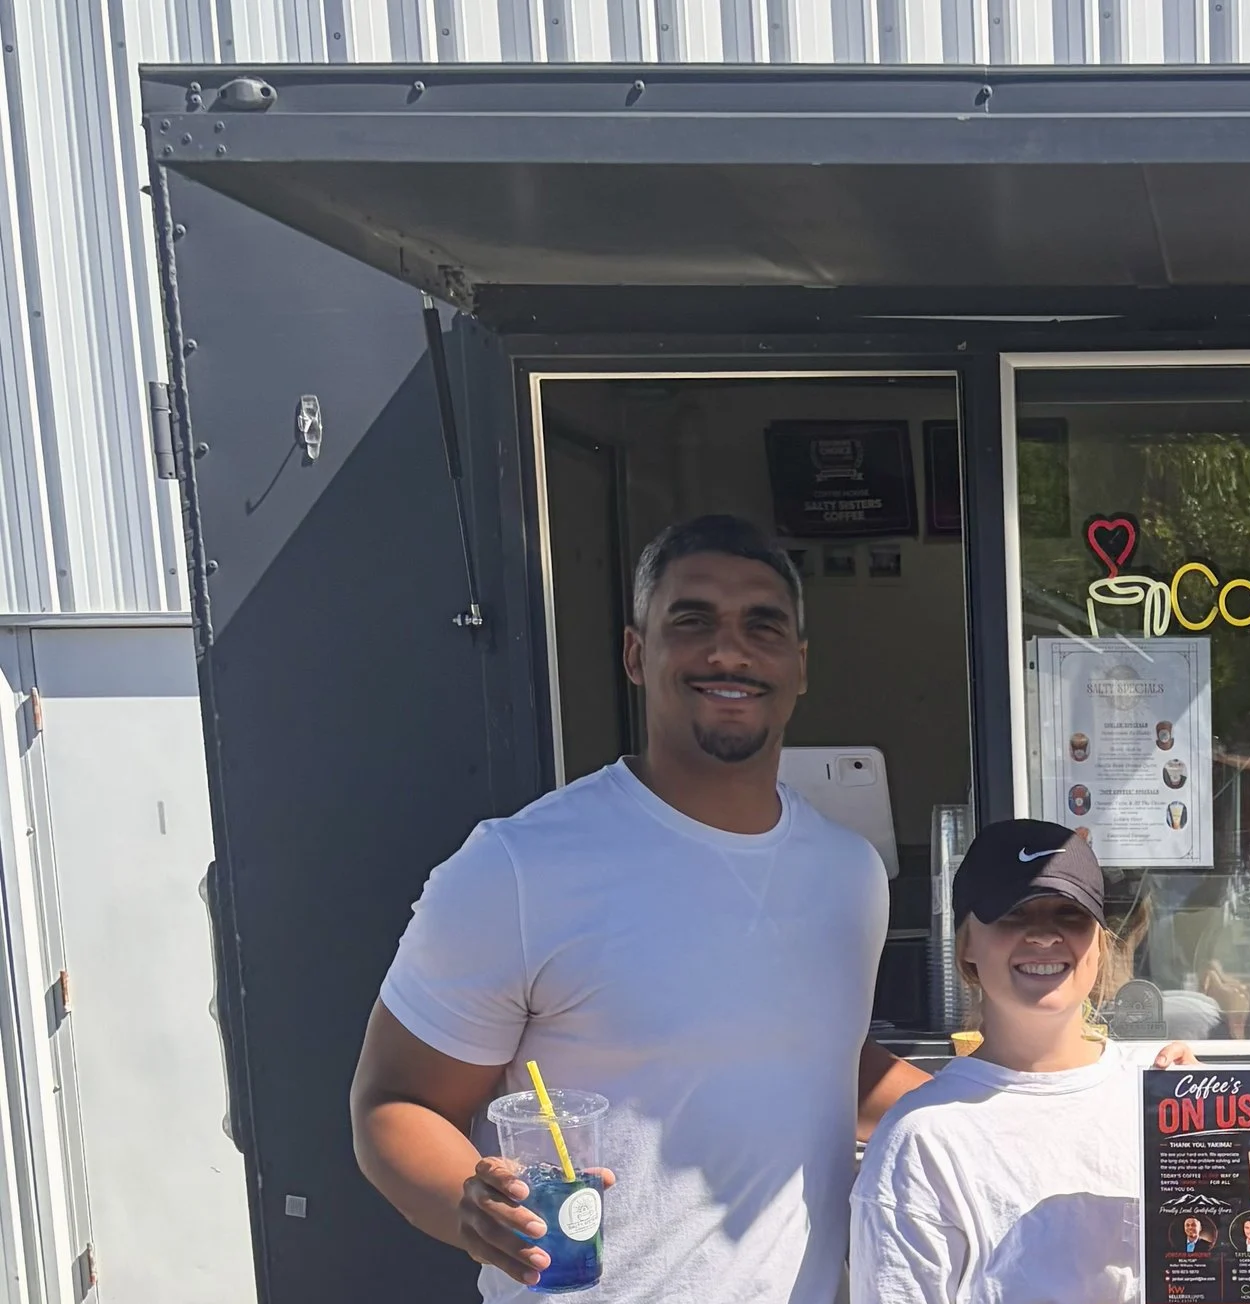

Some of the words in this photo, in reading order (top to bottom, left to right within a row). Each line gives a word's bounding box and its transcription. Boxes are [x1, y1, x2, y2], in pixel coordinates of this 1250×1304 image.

[804, 501, 837, 511] SALTY
[838, 500, 882, 510] SISTERS
[824, 511, 864, 521] COFFEE
[1086, 683, 1114, 694] SALTY
[1117, 683, 1164, 694] SPECIALS
[1174, 1074, 1242, 1099] Coffee's
[1158, 1098, 1205, 1134] ON
[1168, 1284, 1184, 1294] kw
